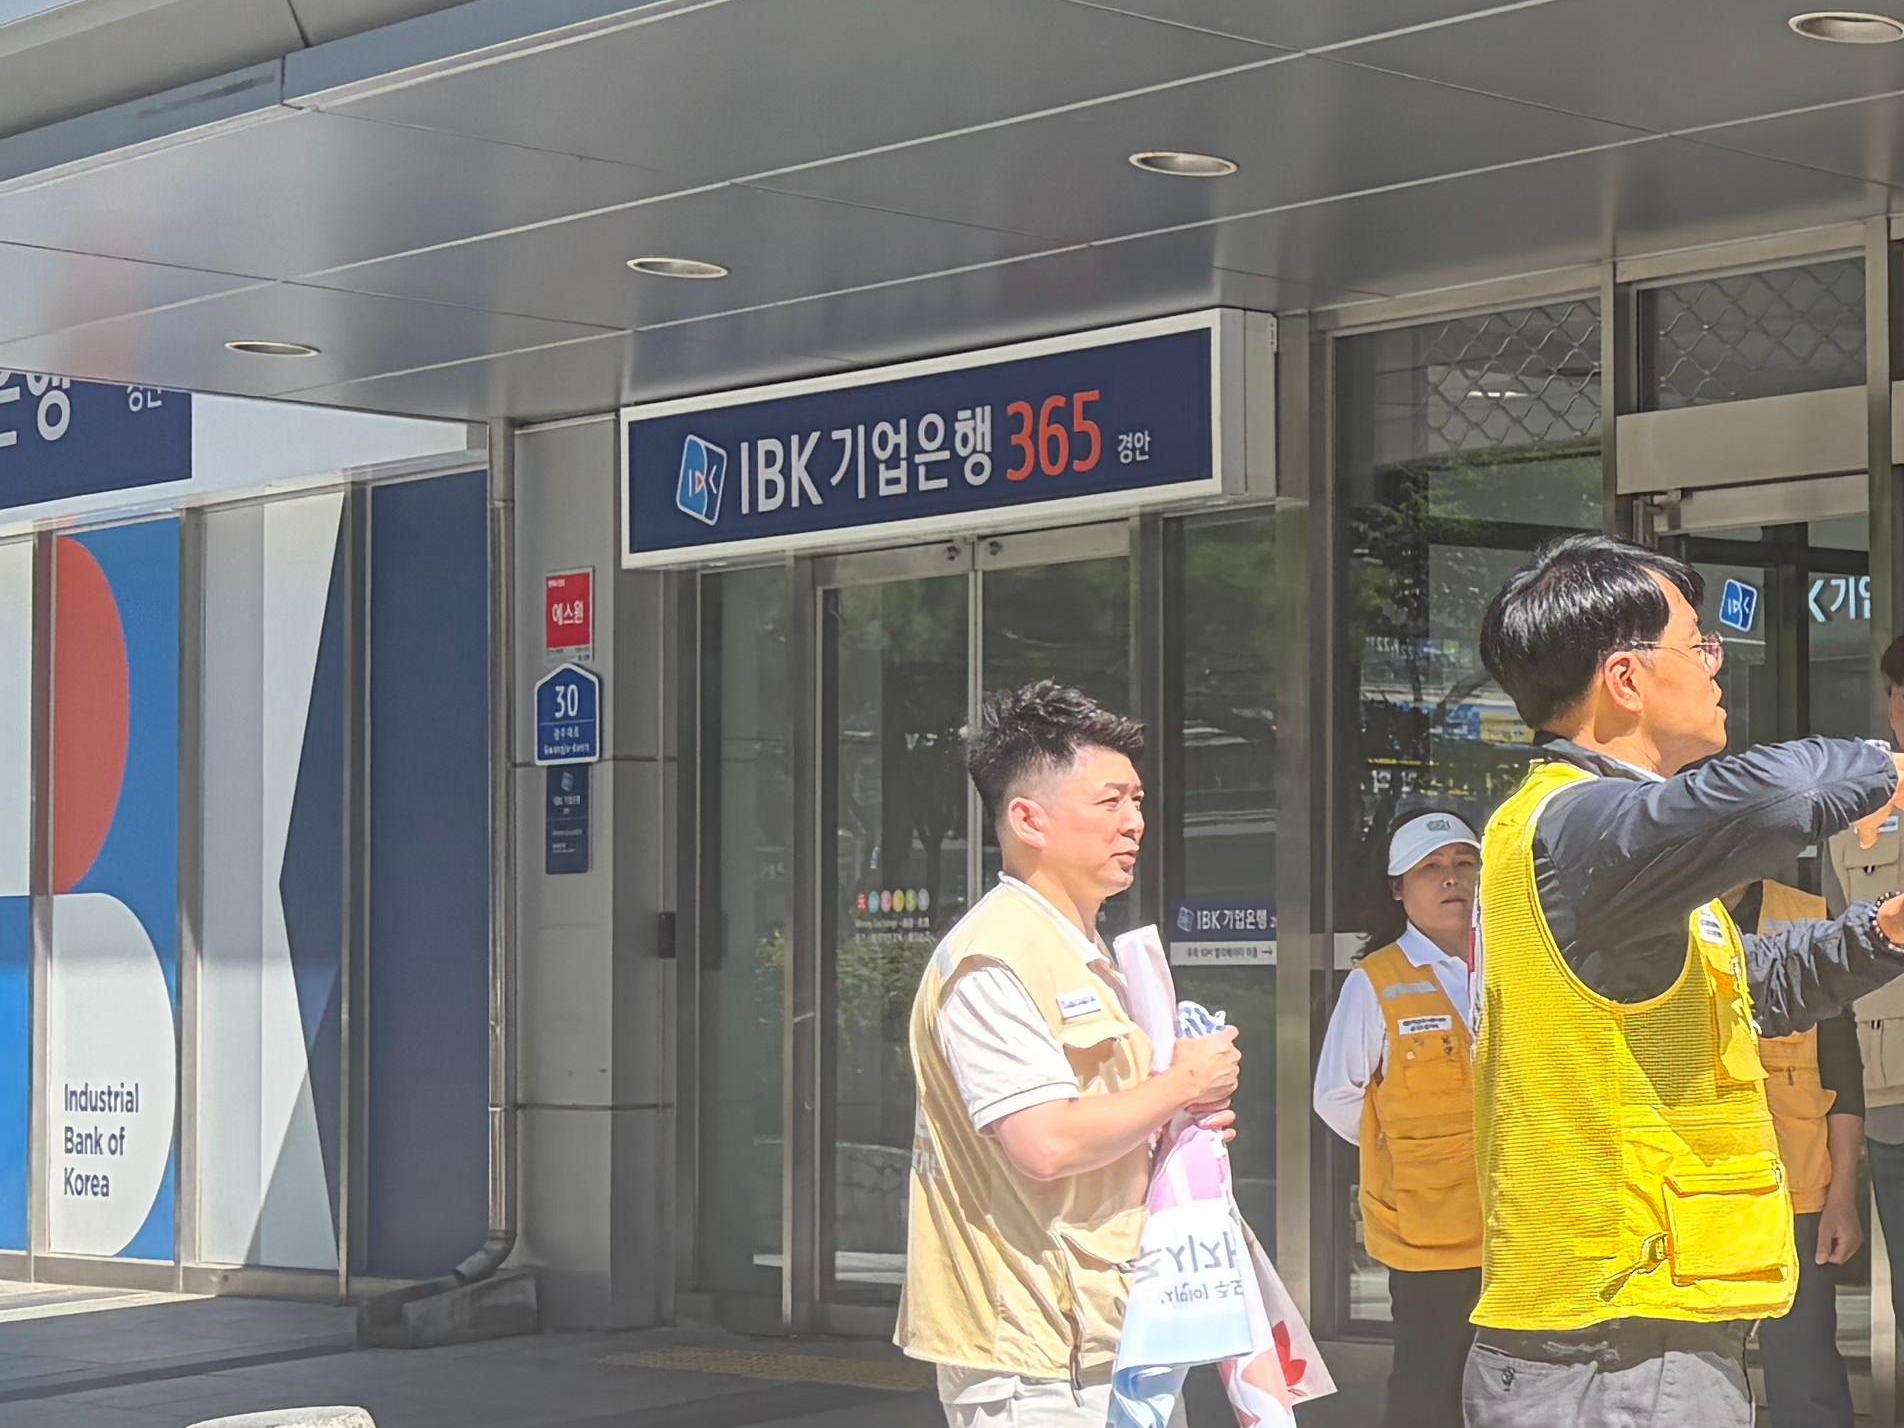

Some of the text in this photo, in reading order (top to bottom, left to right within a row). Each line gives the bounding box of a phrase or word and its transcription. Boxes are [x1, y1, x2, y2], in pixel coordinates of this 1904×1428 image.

[1005, 389, 1102, 482] 365
[1117, 429, 1151, 464] 경안
[552, 600, 584, 625] 에스원
[555, 684, 578, 718] 30
[65, 1082, 139, 1113] Industrial
[64, 1125, 125, 1156] Bank of
[64, 1167, 110, 1197] Korea
